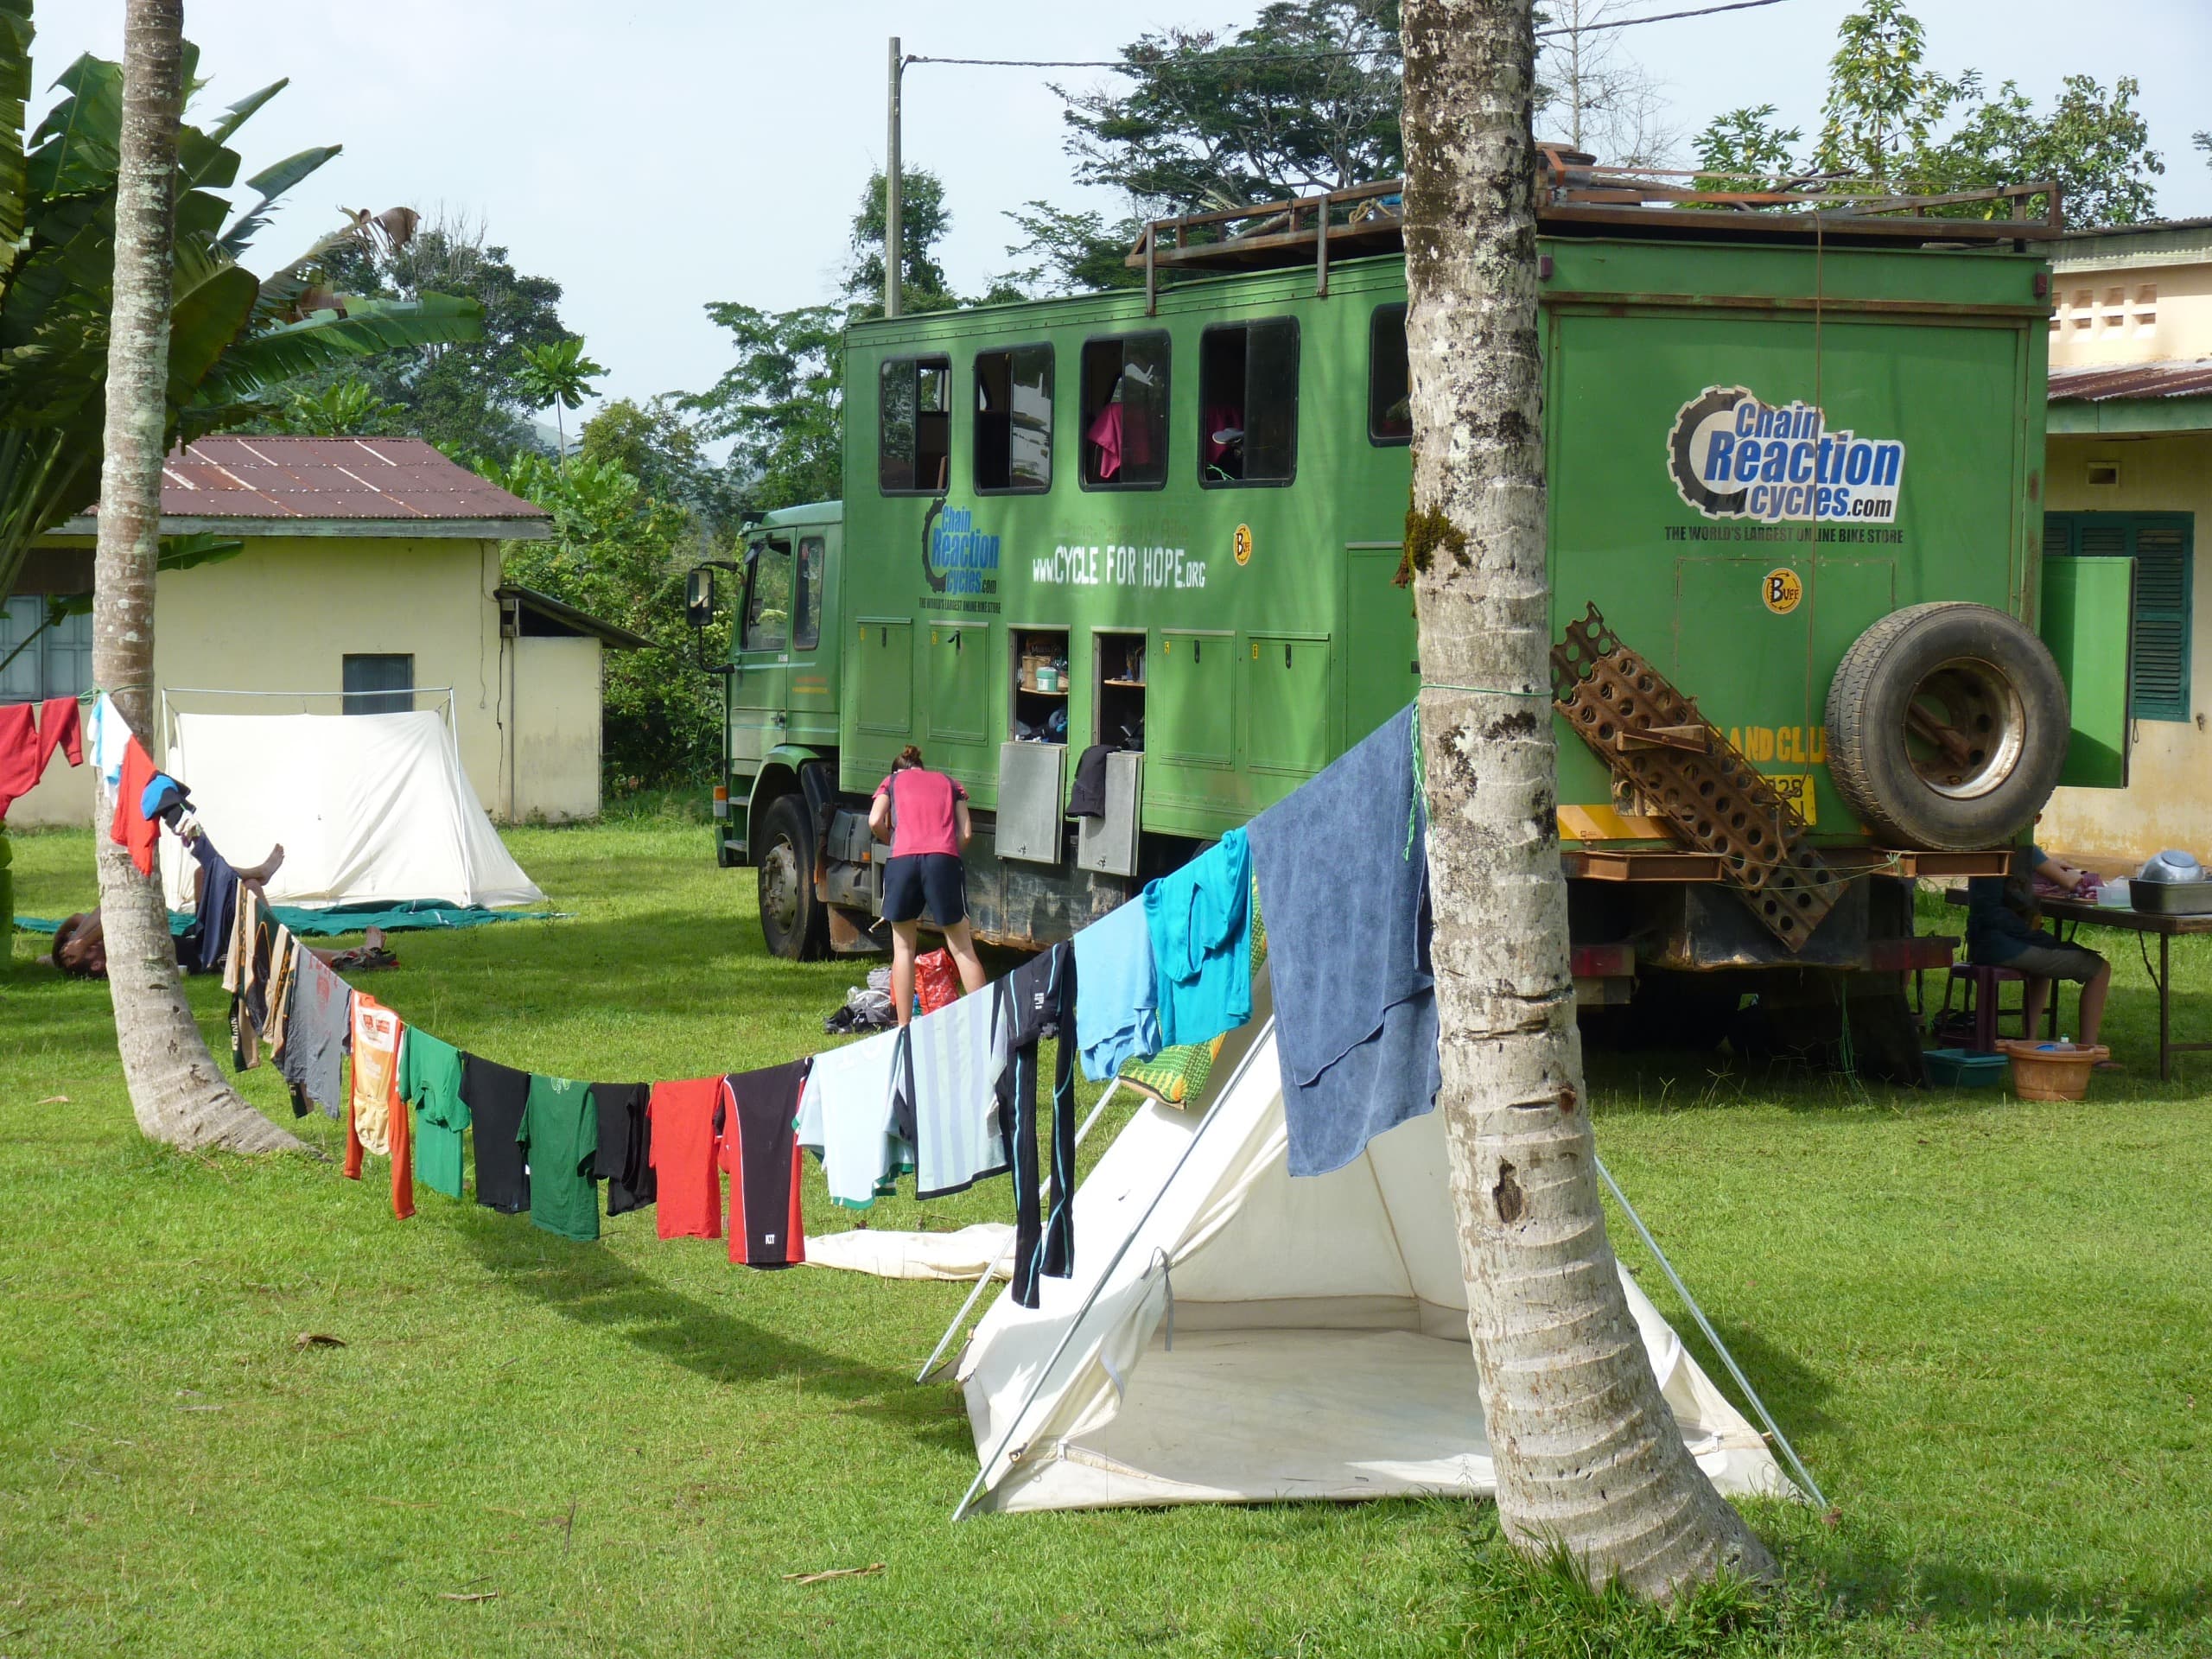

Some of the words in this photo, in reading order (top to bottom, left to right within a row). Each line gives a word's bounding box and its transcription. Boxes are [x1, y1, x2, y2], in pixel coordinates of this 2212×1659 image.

[1735, 402, 1821, 439] Chain
[1703, 430, 1900, 486] Reaction
[942, 505, 971, 532] Chain
[1665, 526, 1687, 541] THE
[1688, 526, 1742, 542] WORLD'S
[1744, 527, 1793, 542] LARGEST
[1839, 528, 1866, 543] BIKE
[1867, 529, 1904, 543] STORE
[931, 528, 1000, 569] Reaction
[1106, 545, 1136, 586] FOR
[1714, 726, 1774, 762] AND
